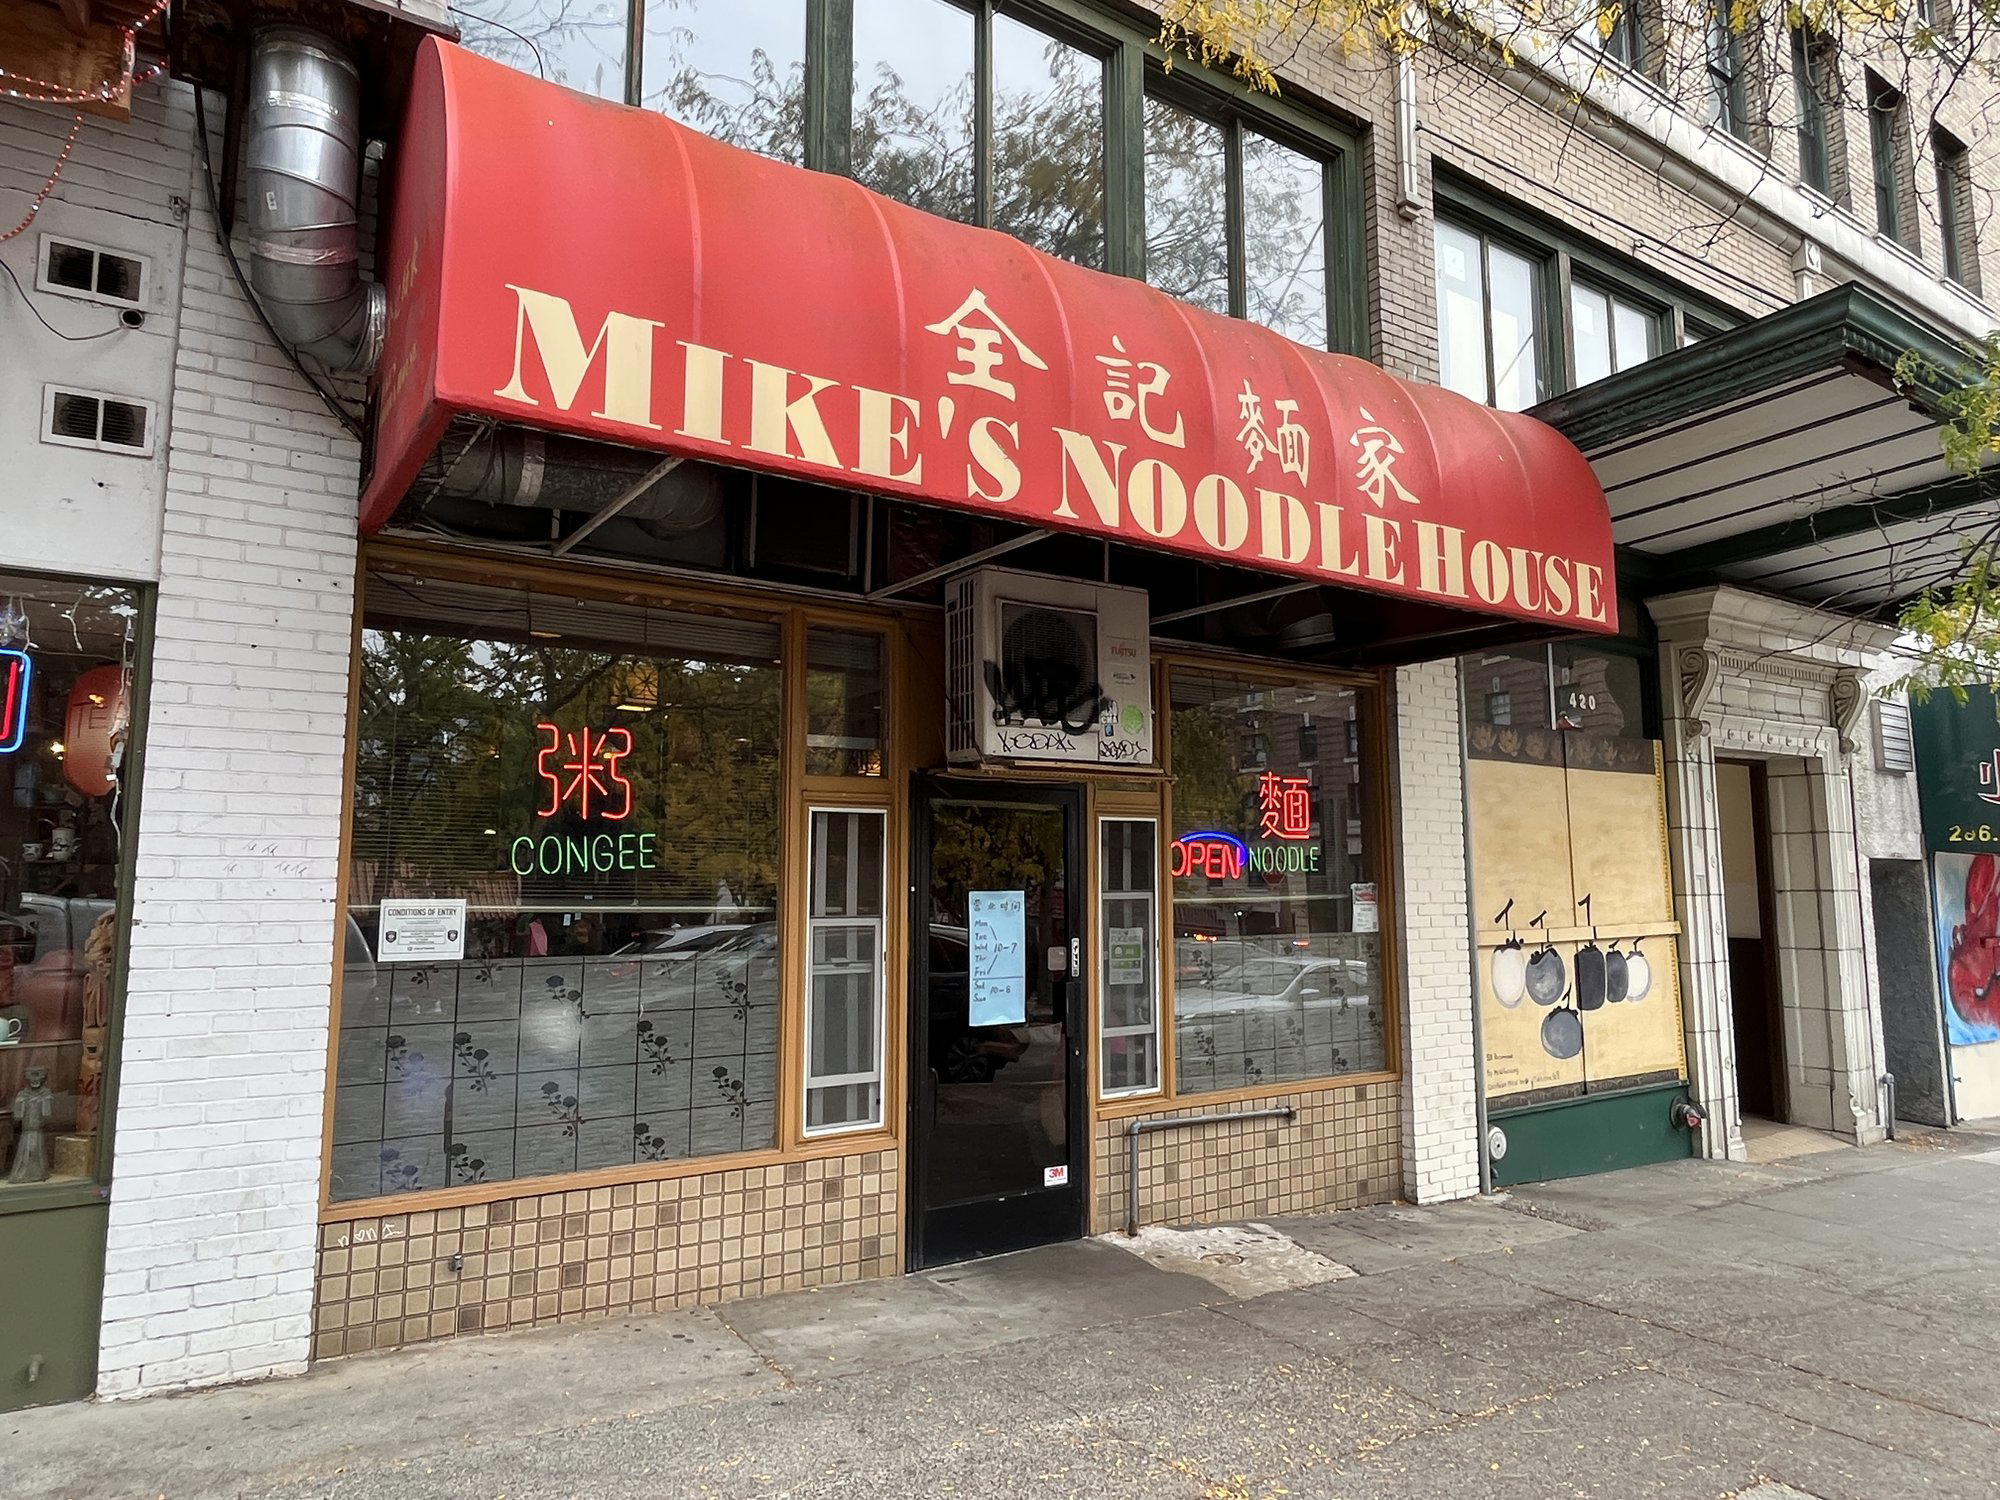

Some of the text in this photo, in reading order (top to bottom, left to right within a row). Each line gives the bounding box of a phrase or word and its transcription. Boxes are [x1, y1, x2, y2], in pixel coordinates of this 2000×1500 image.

[493, 283, 1022, 503] MIKE'S
[1052, 426, 1406, 586] NOODLE
[1411, 518, 1607, 624] HOUSE
[1569, 692, 1597, 711] 420
[537, 723, 632, 821] 粥
[1259, 771, 1310, 840] 麵
[511, 834, 656, 875] CONGEE
[1170, 840, 1242, 880] OPEN
[1249, 846, 1319, 873] NOODLE
[387, 907, 458, 917] CONDITIONS OF ENTRY
[1048, 1167, 1064, 1178] 3M
